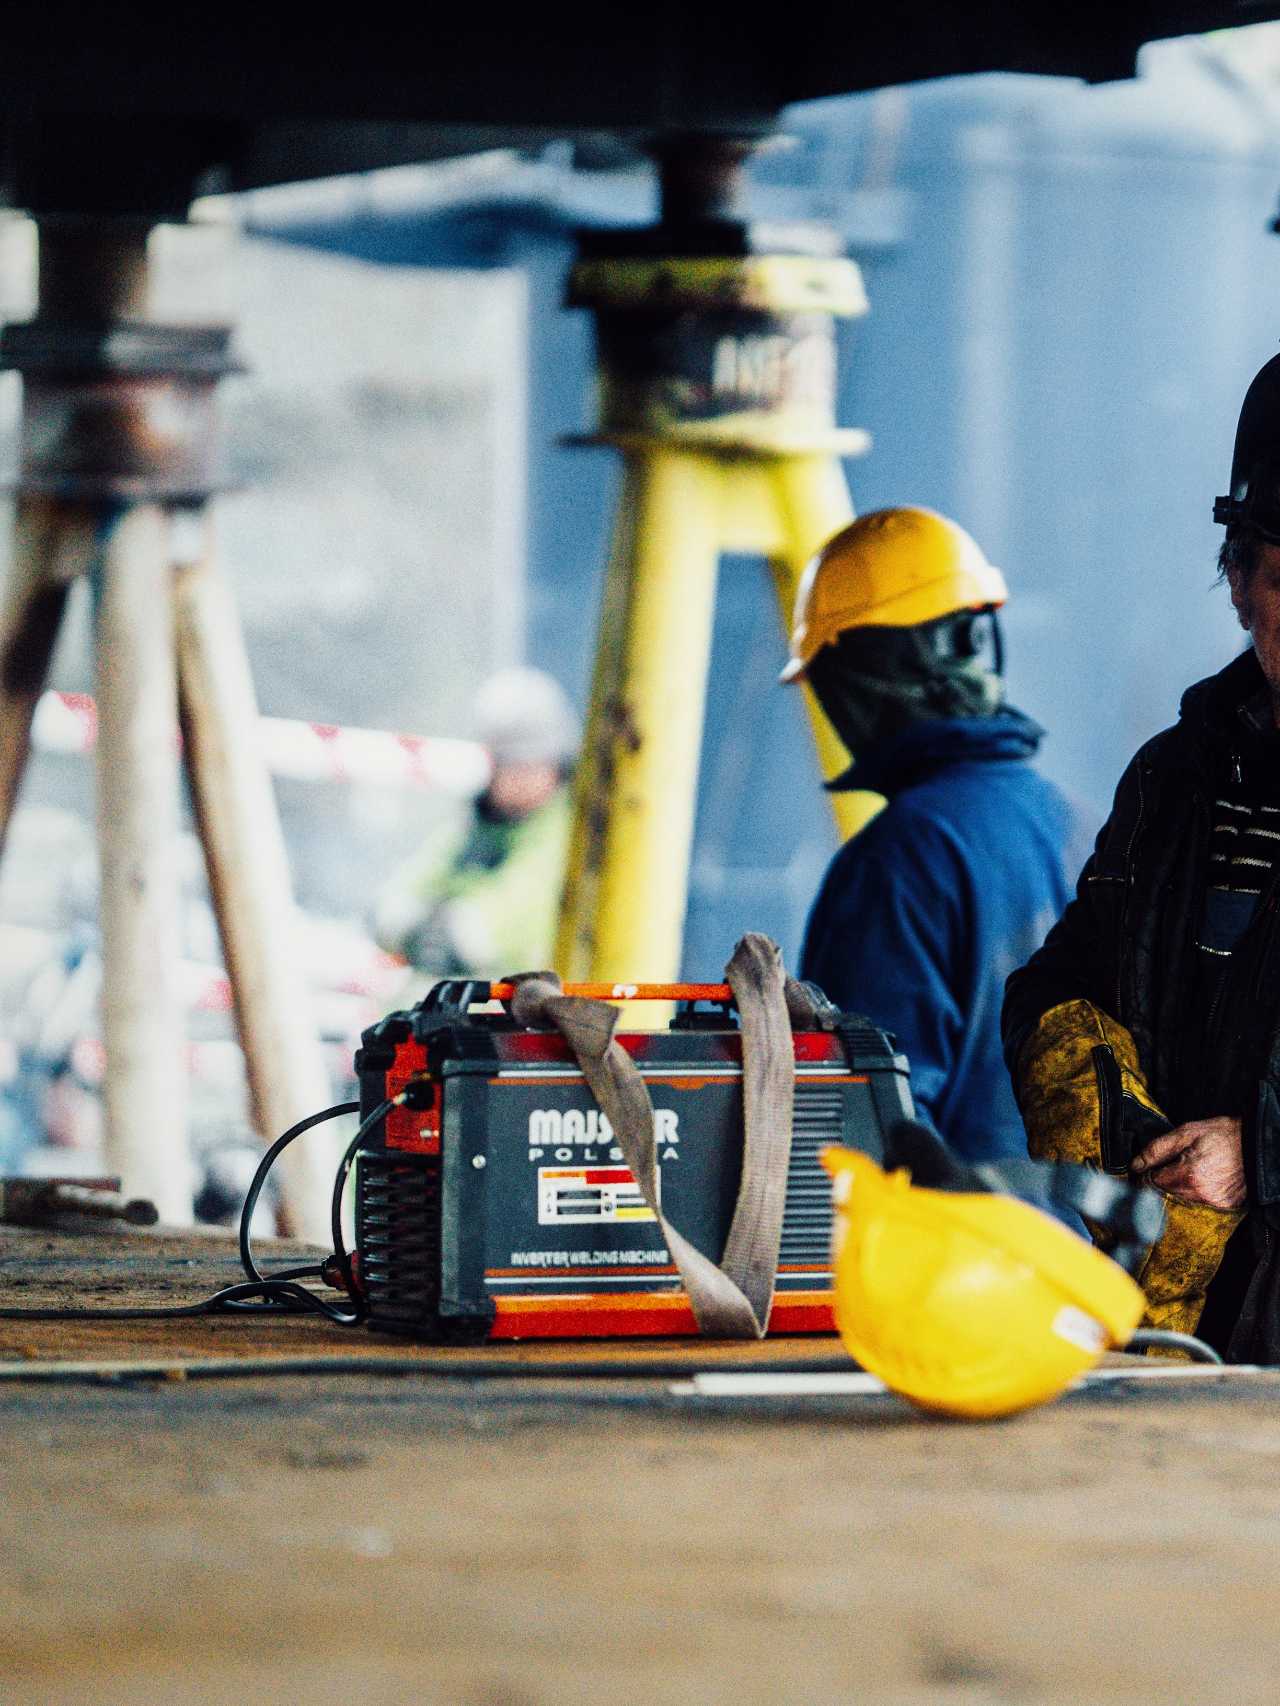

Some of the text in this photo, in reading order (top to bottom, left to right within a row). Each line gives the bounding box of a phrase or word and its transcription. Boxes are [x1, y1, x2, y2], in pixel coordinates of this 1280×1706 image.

[529, 1109, 680, 1145] MAJSR
[529, 1148, 679, 1161] POLSA
[511, 1251, 570, 1267] INVERTER
[571, 1250, 618, 1265] WELDING
